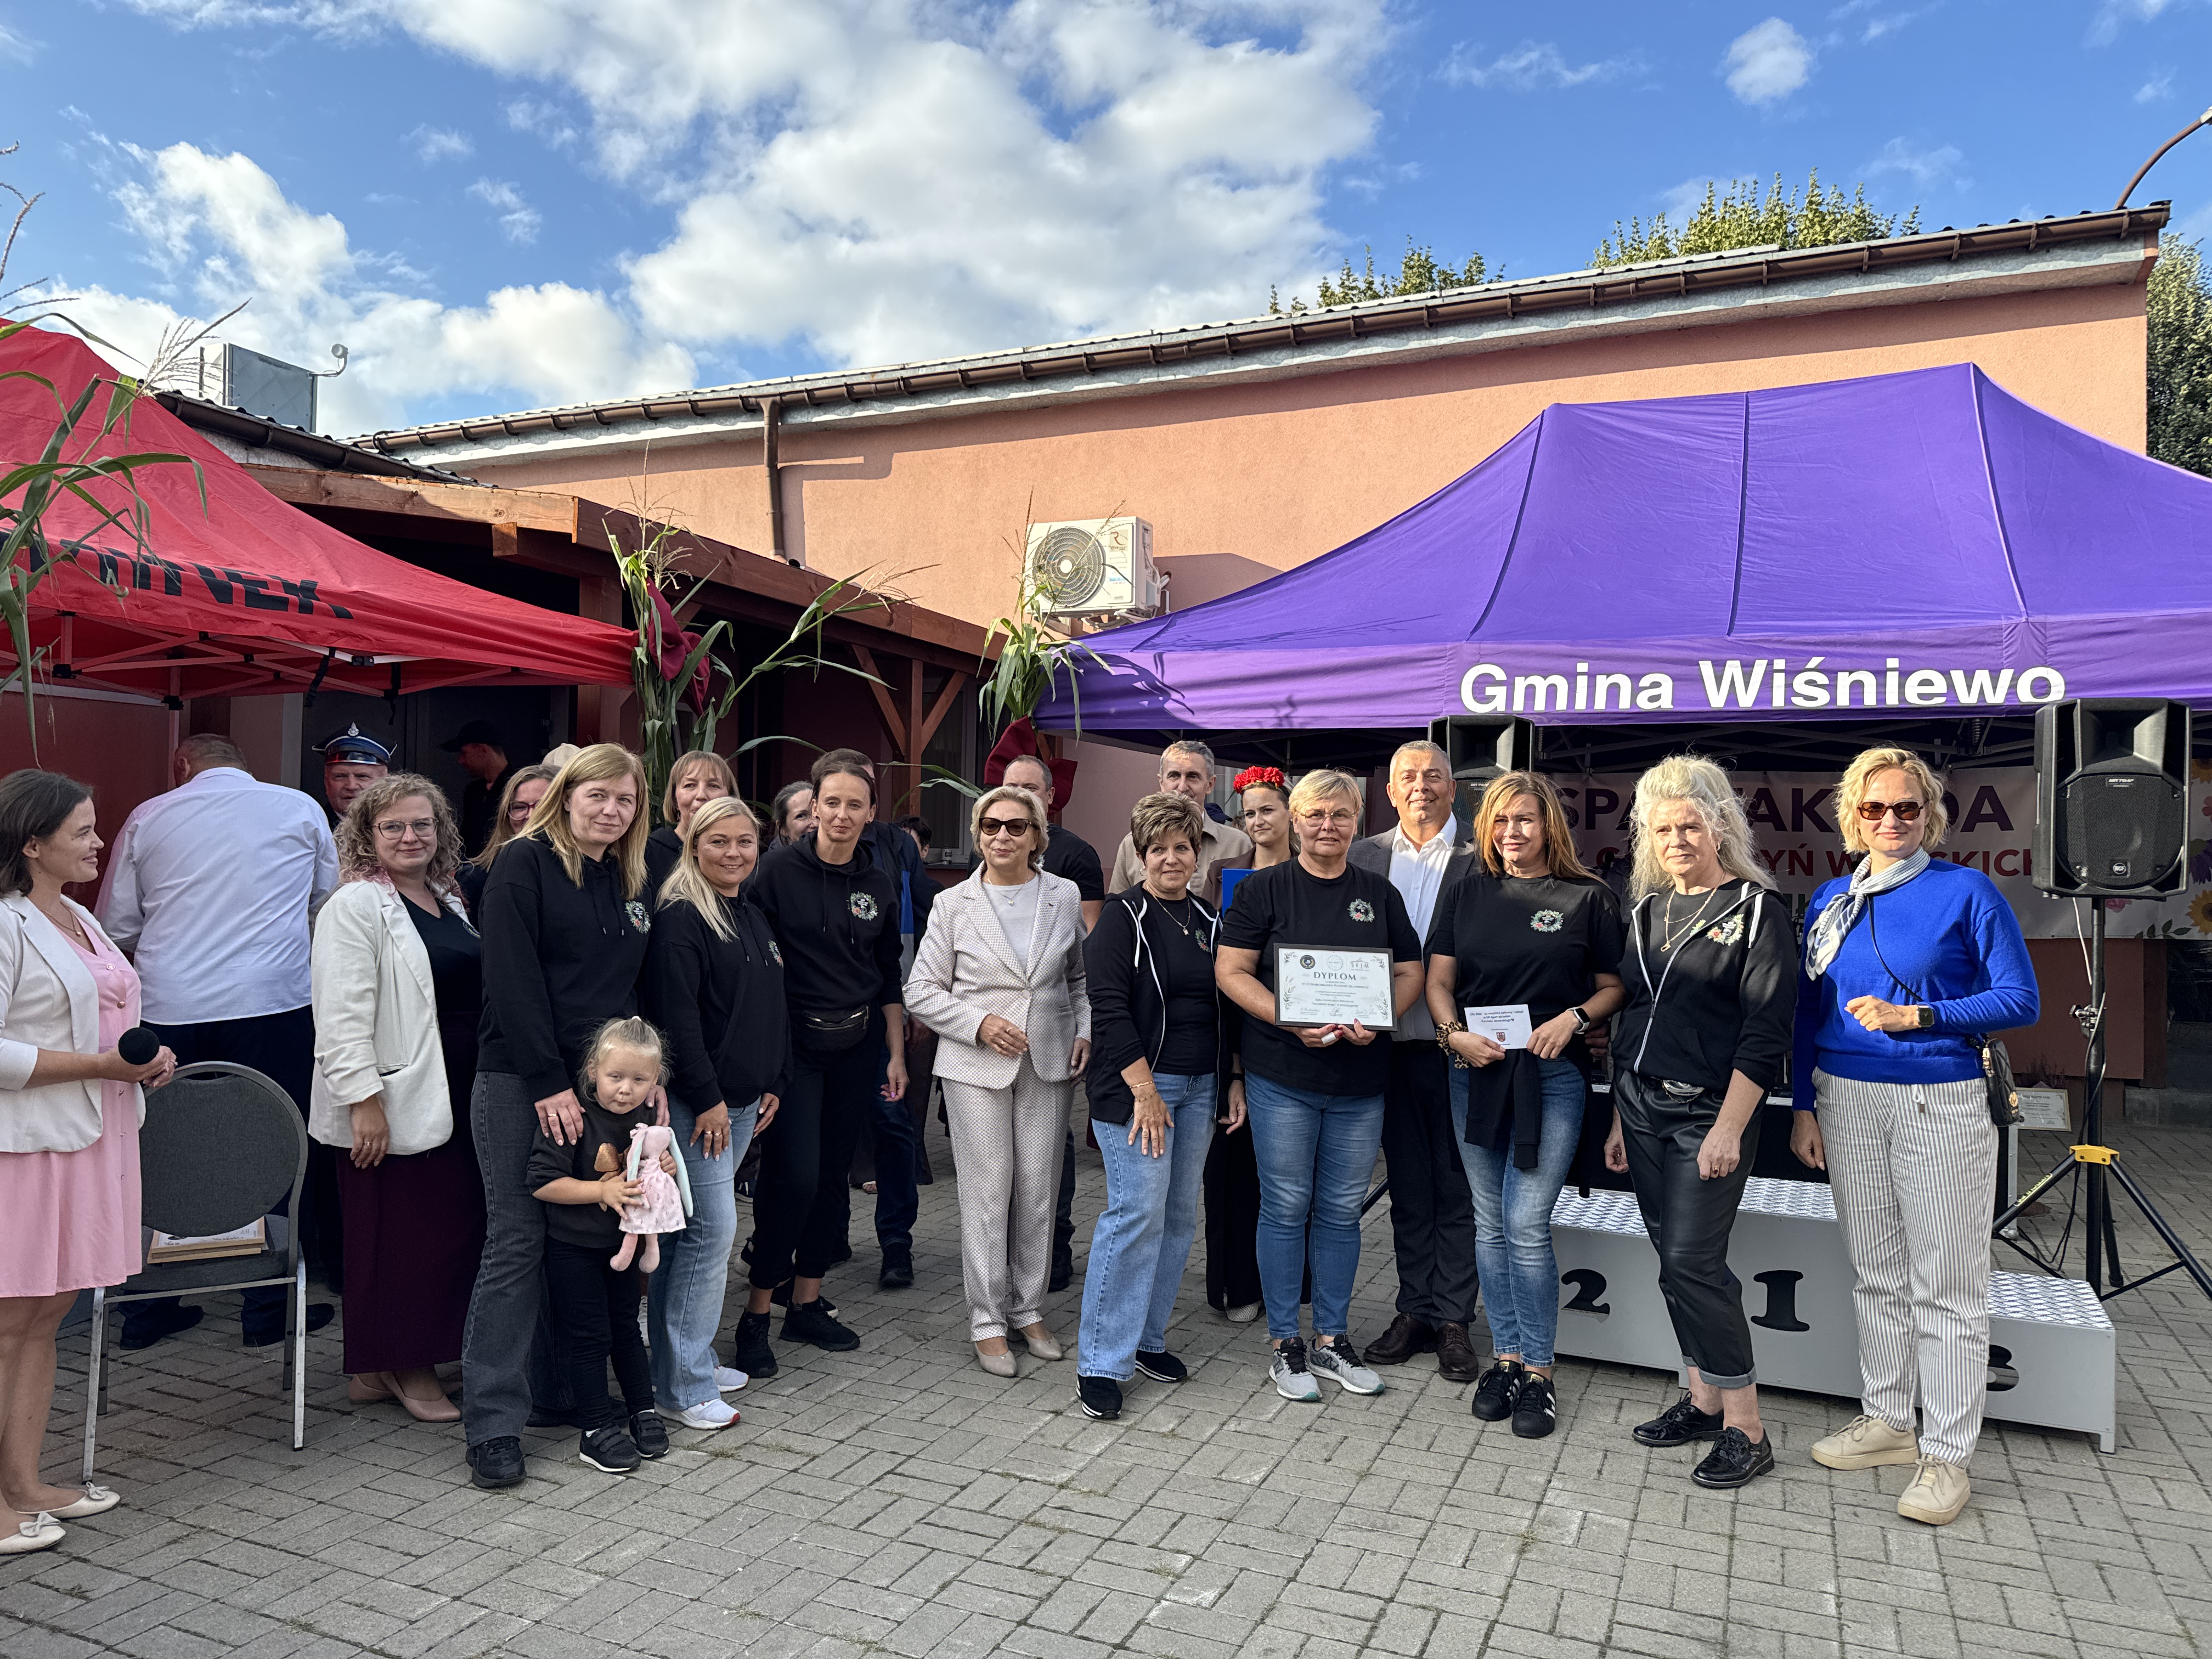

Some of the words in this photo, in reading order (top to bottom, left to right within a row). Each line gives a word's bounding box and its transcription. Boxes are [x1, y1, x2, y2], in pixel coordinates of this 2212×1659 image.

[1460, 662, 1674, 714] Gmina
[1698, 656, 2066, 708] Wiśniewo
[1313, 972, 1356, 981] DYPLOM
[1560, 1268, 1610, 1323] 2
[1750, 1269, 1810, 1332] 1
